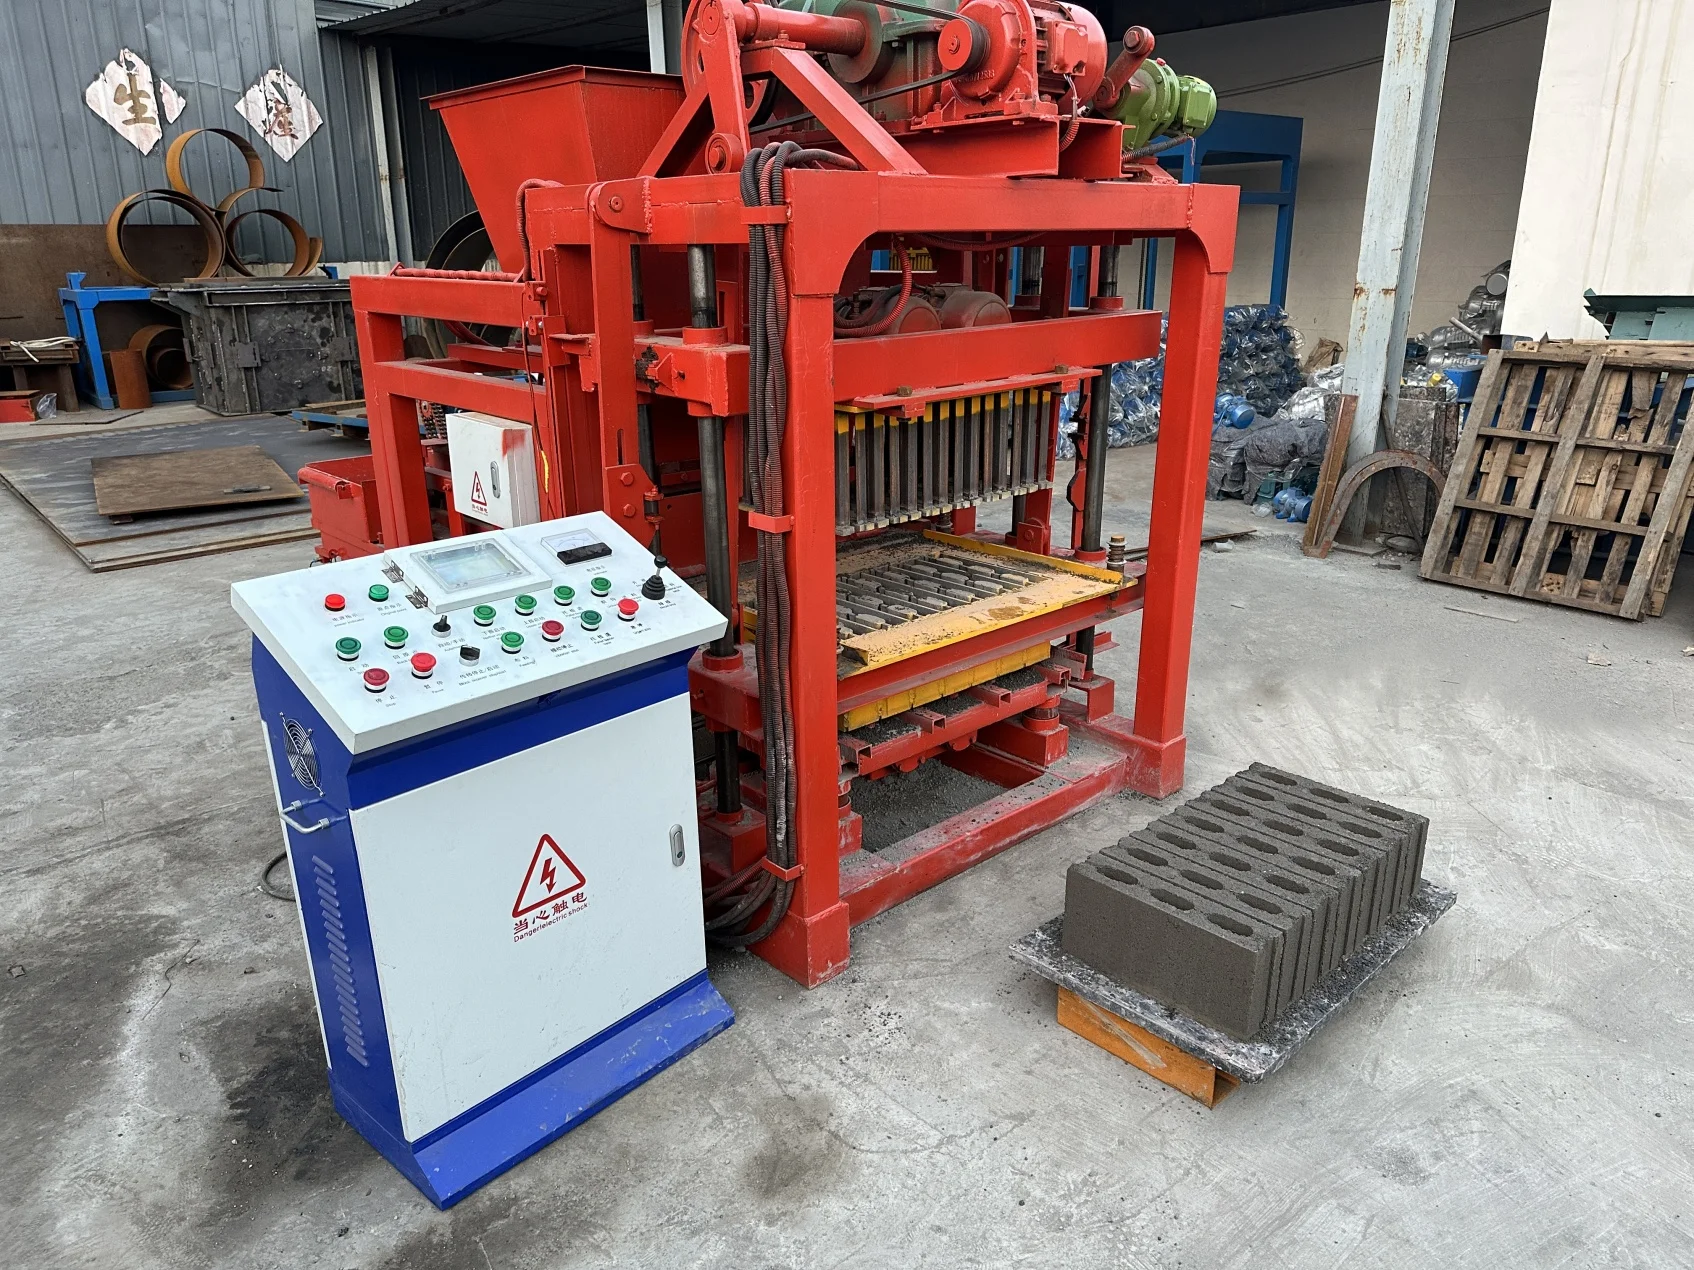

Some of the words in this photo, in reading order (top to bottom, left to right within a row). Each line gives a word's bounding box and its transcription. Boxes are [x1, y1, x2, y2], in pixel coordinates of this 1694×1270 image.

[114, 73, 157, 126] 生
[513, 891, 588, 936] 当心触电
